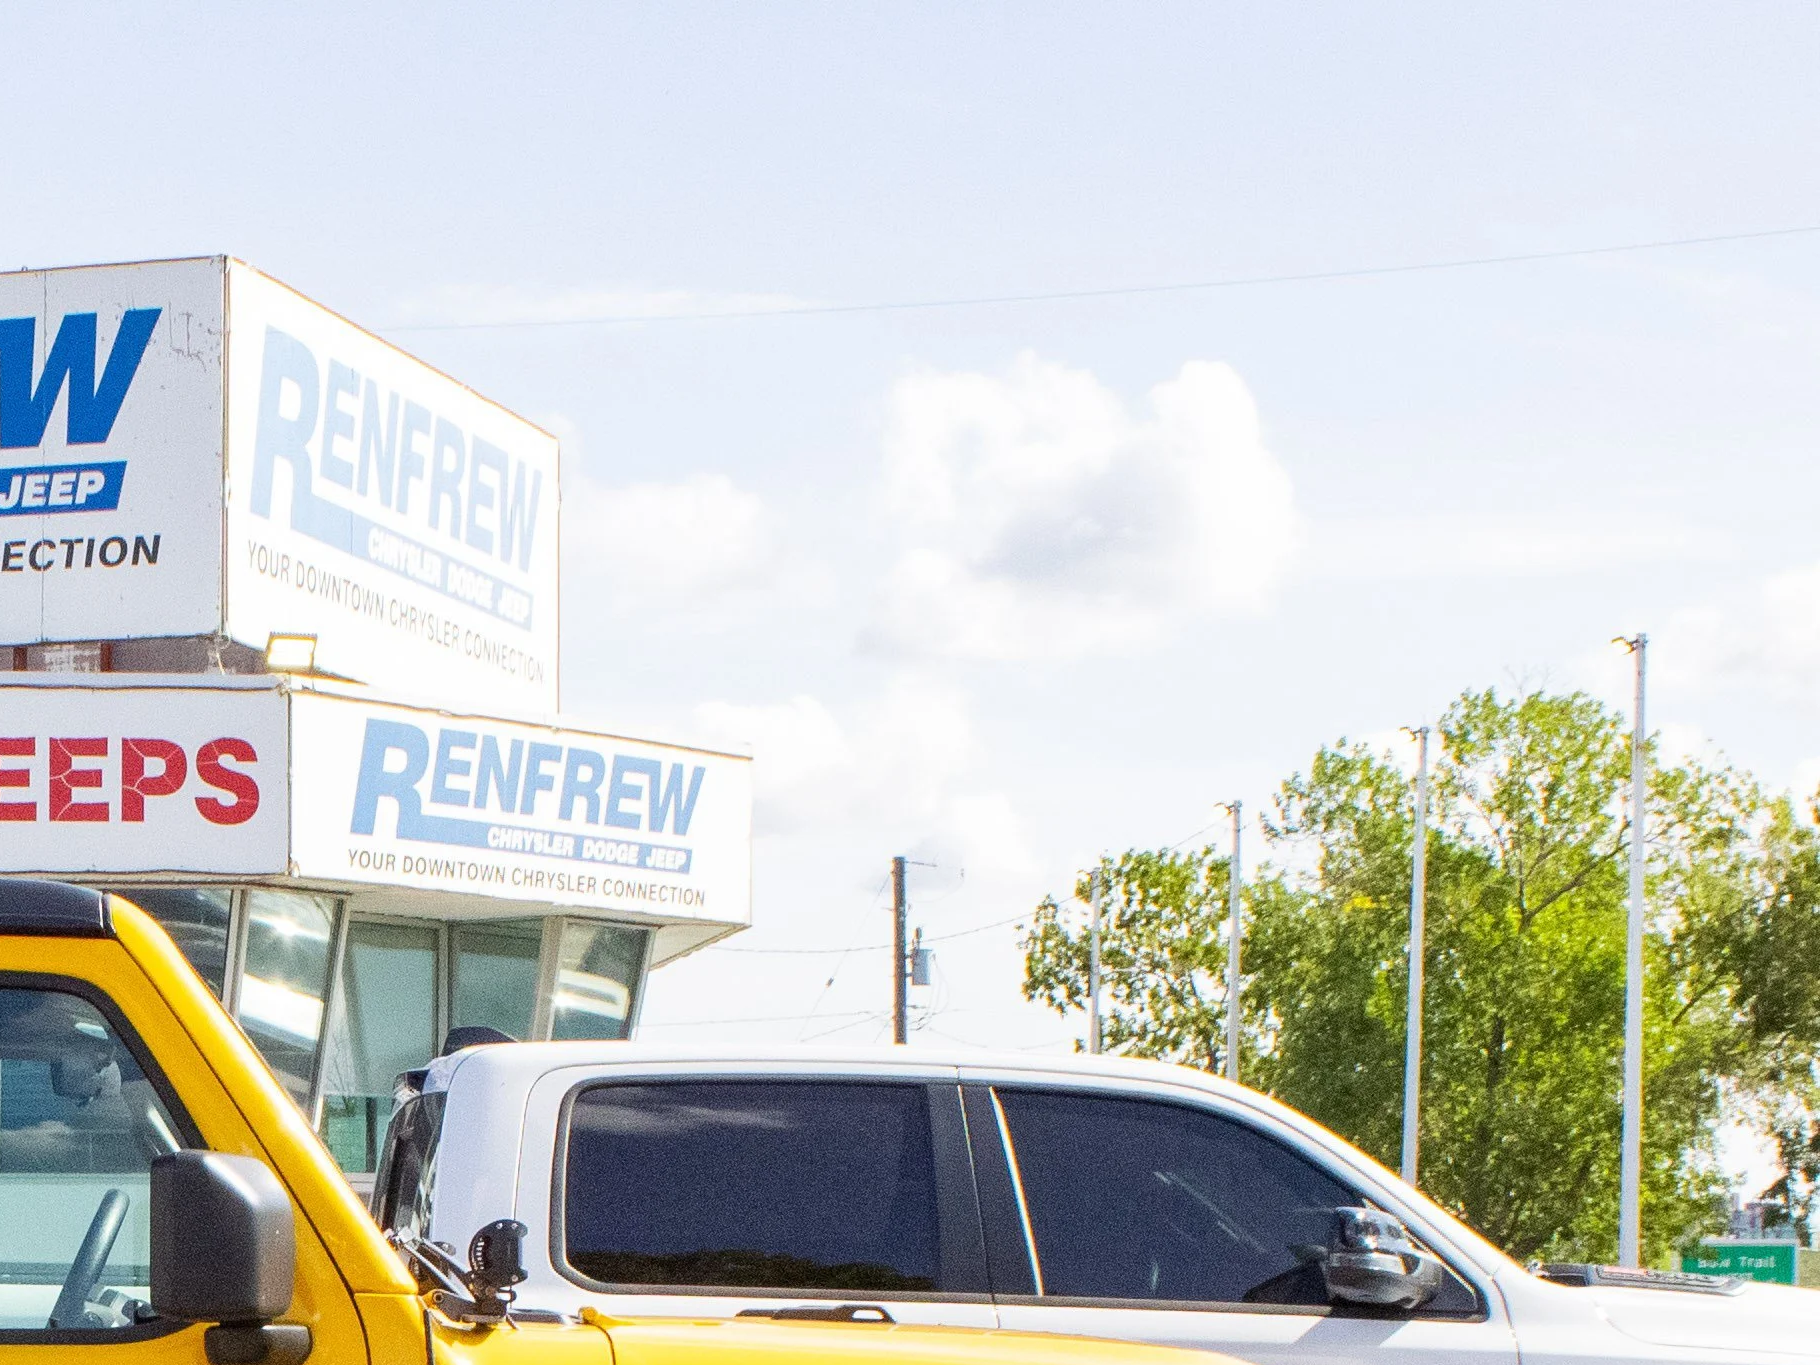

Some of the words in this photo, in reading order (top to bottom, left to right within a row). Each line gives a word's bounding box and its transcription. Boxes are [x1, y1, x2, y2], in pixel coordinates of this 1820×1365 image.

[249, 323, 543, 575] RENFREW
[248, 539, 290, 584] YOUR
[296, 560, 385, 620] DOWNTOWN
[389, 598, 461, 650] CHRYSLER
[465, 629, 546, 684] CONNECTION
[349, 717, 706, 837] RENFREW
[348, 848, 396, 872] YOUR
[402, 856, 506, 883] DOWNTOWN
[512, 868, 597, 896] CHRYSLER
[603, 878, 705, 907] CONNECTION
[487, 826, 574, 858] CHRYSLER
[582, 838, 640, 866] DODGE
[646, 846, 687, 871] JEEP
[1739, 1255, 1777, 1269] Trail
